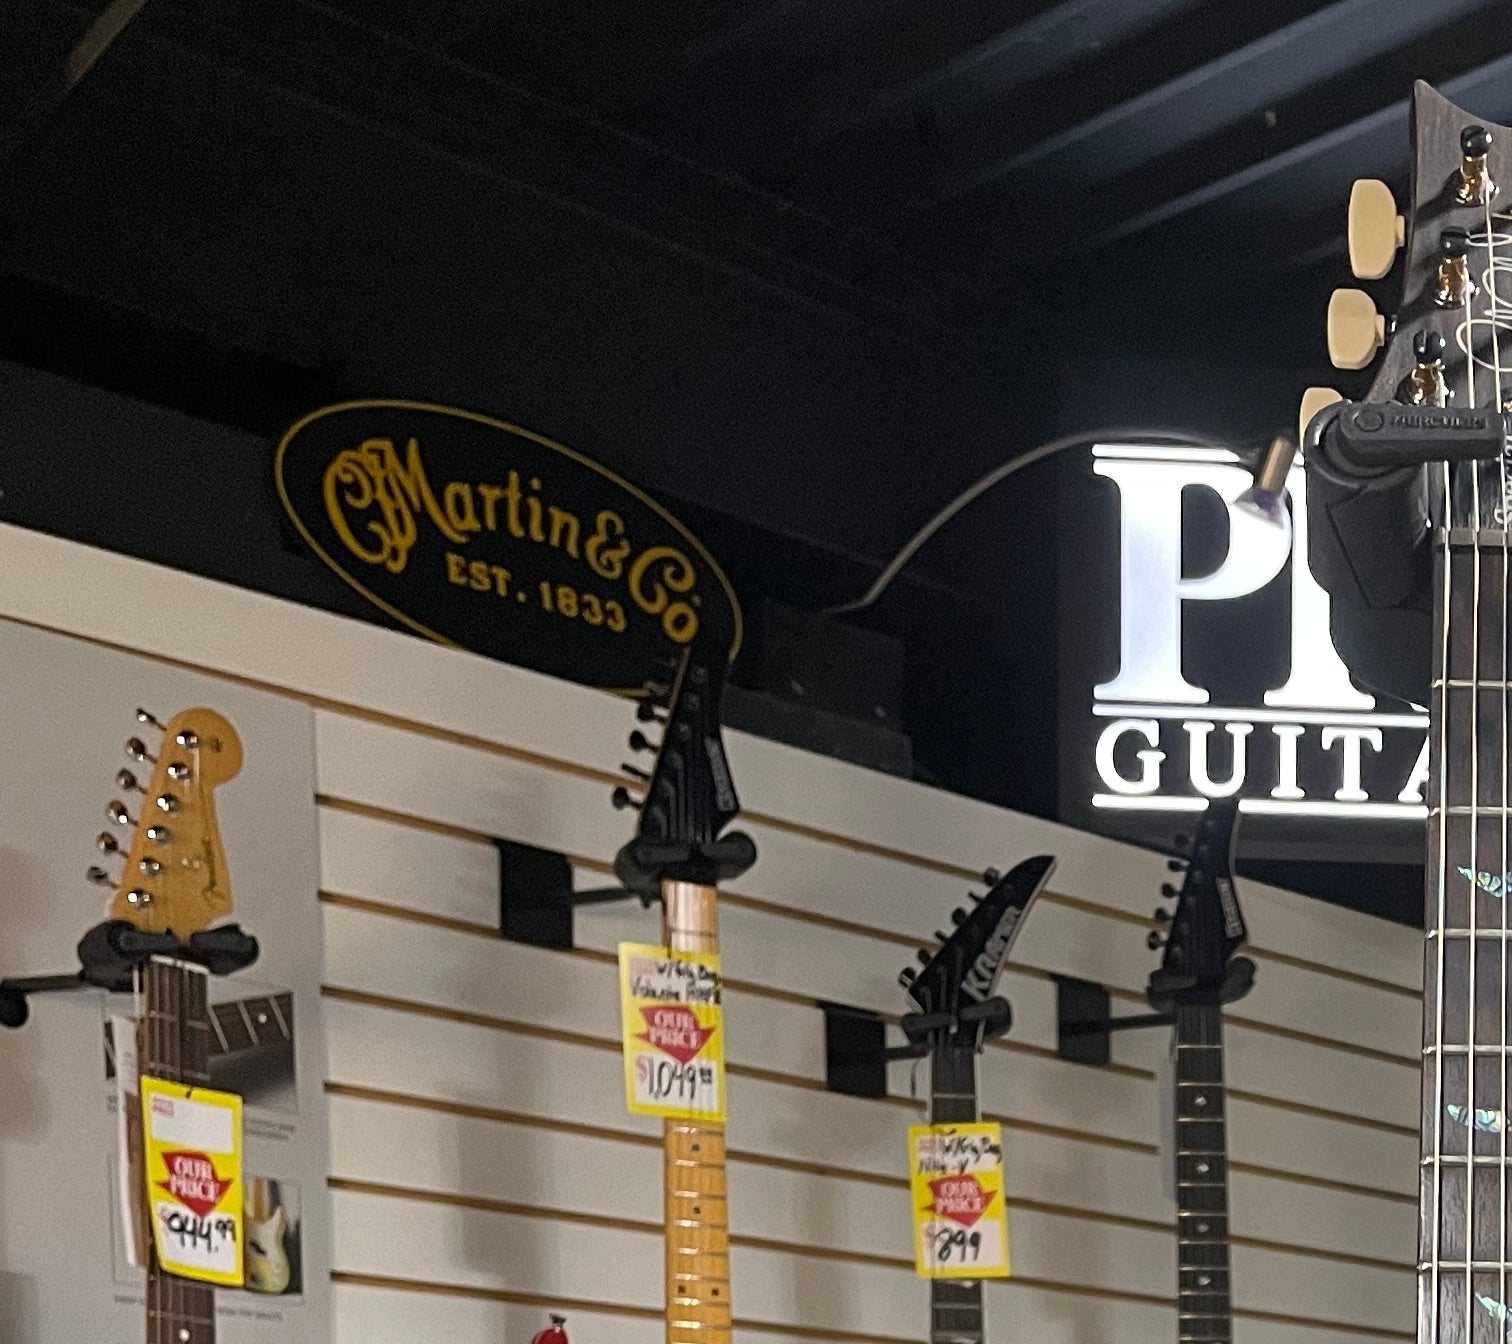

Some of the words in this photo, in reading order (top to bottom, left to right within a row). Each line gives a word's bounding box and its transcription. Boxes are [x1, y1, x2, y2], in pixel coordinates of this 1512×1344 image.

[446, 552, 526, 602] EST.
[539, 581, 627, 633] 1833
[173, 1155, 213, 1178] OUR
[170, 1176, 220, 1203] PRICE
